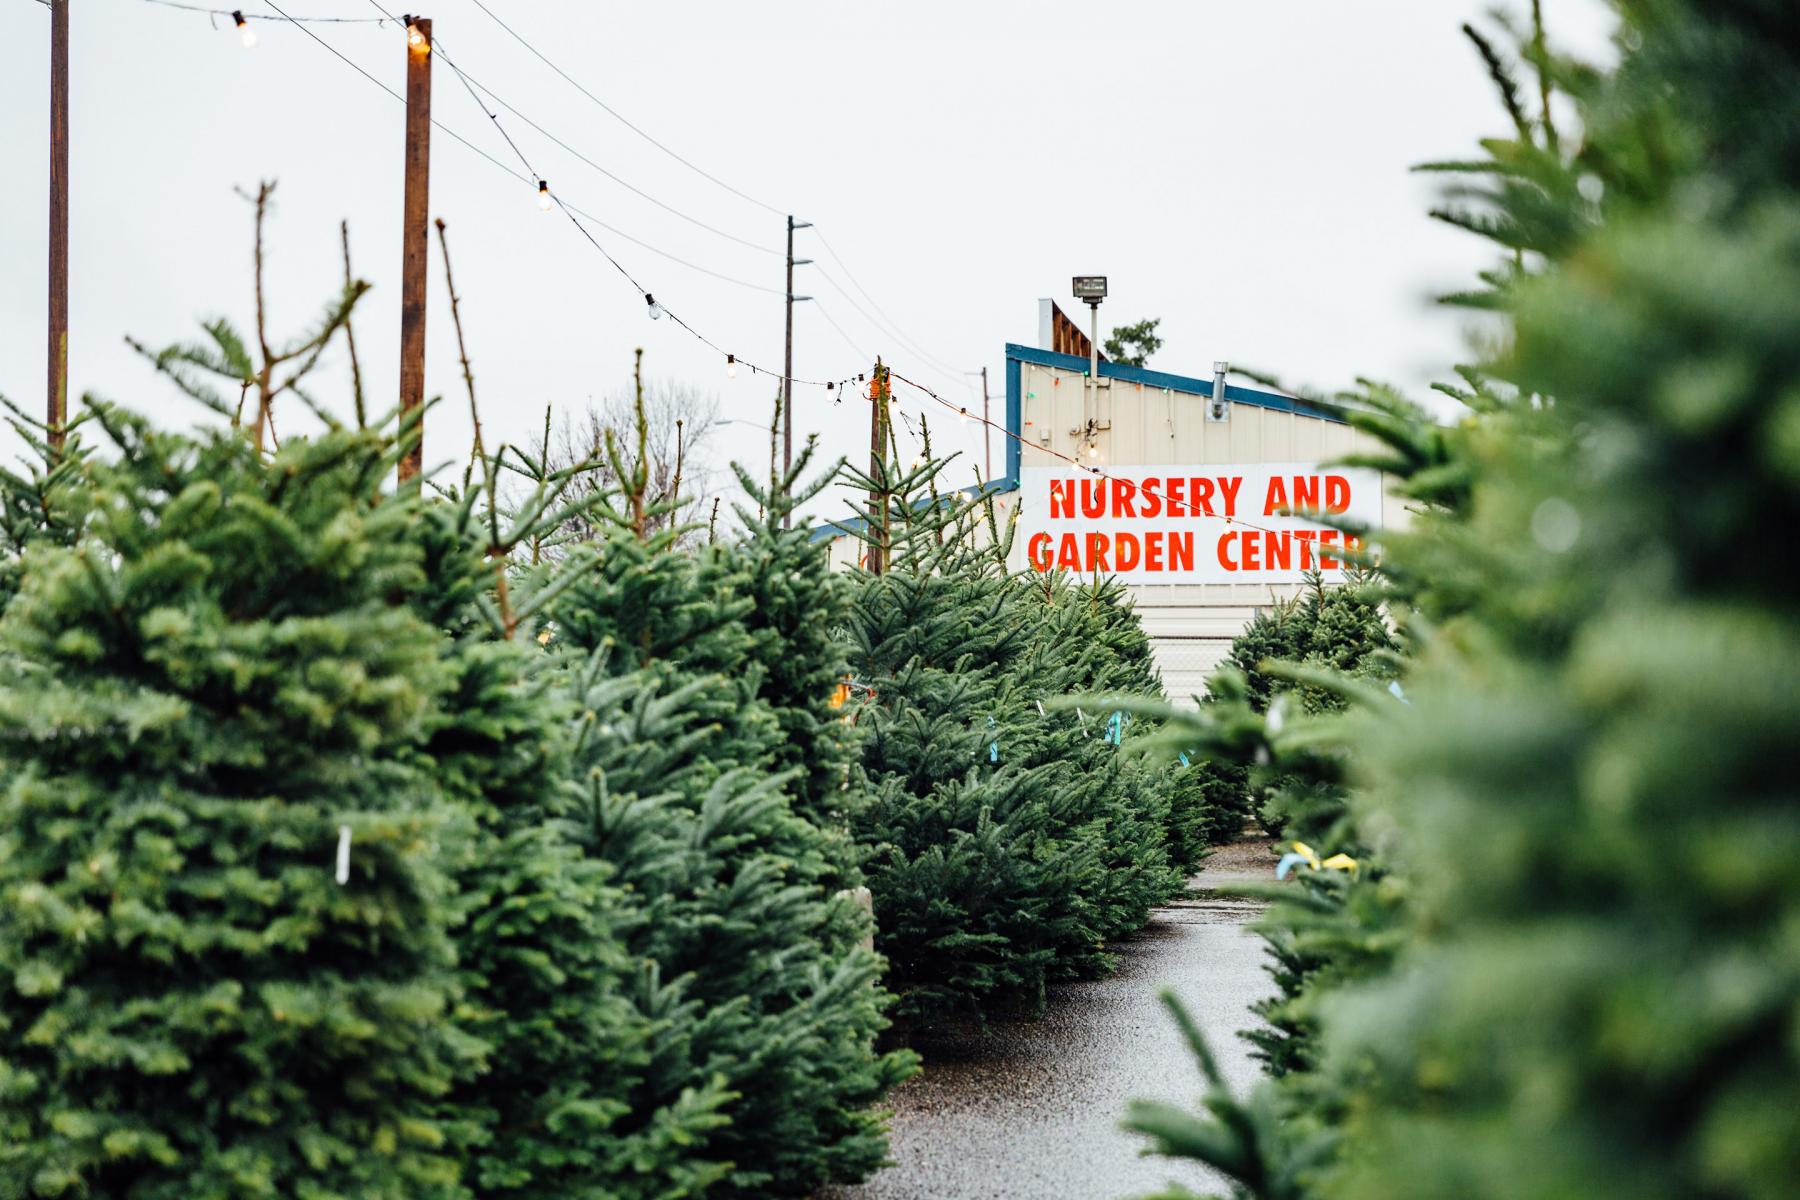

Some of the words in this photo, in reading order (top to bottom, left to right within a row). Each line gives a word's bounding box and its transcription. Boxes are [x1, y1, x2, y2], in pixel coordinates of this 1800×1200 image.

[1050, 476, 1243, 519] NURSERY
[1264, 475, 1352, 516] AND
[1028, 531, 1194, 572] GARDEN
